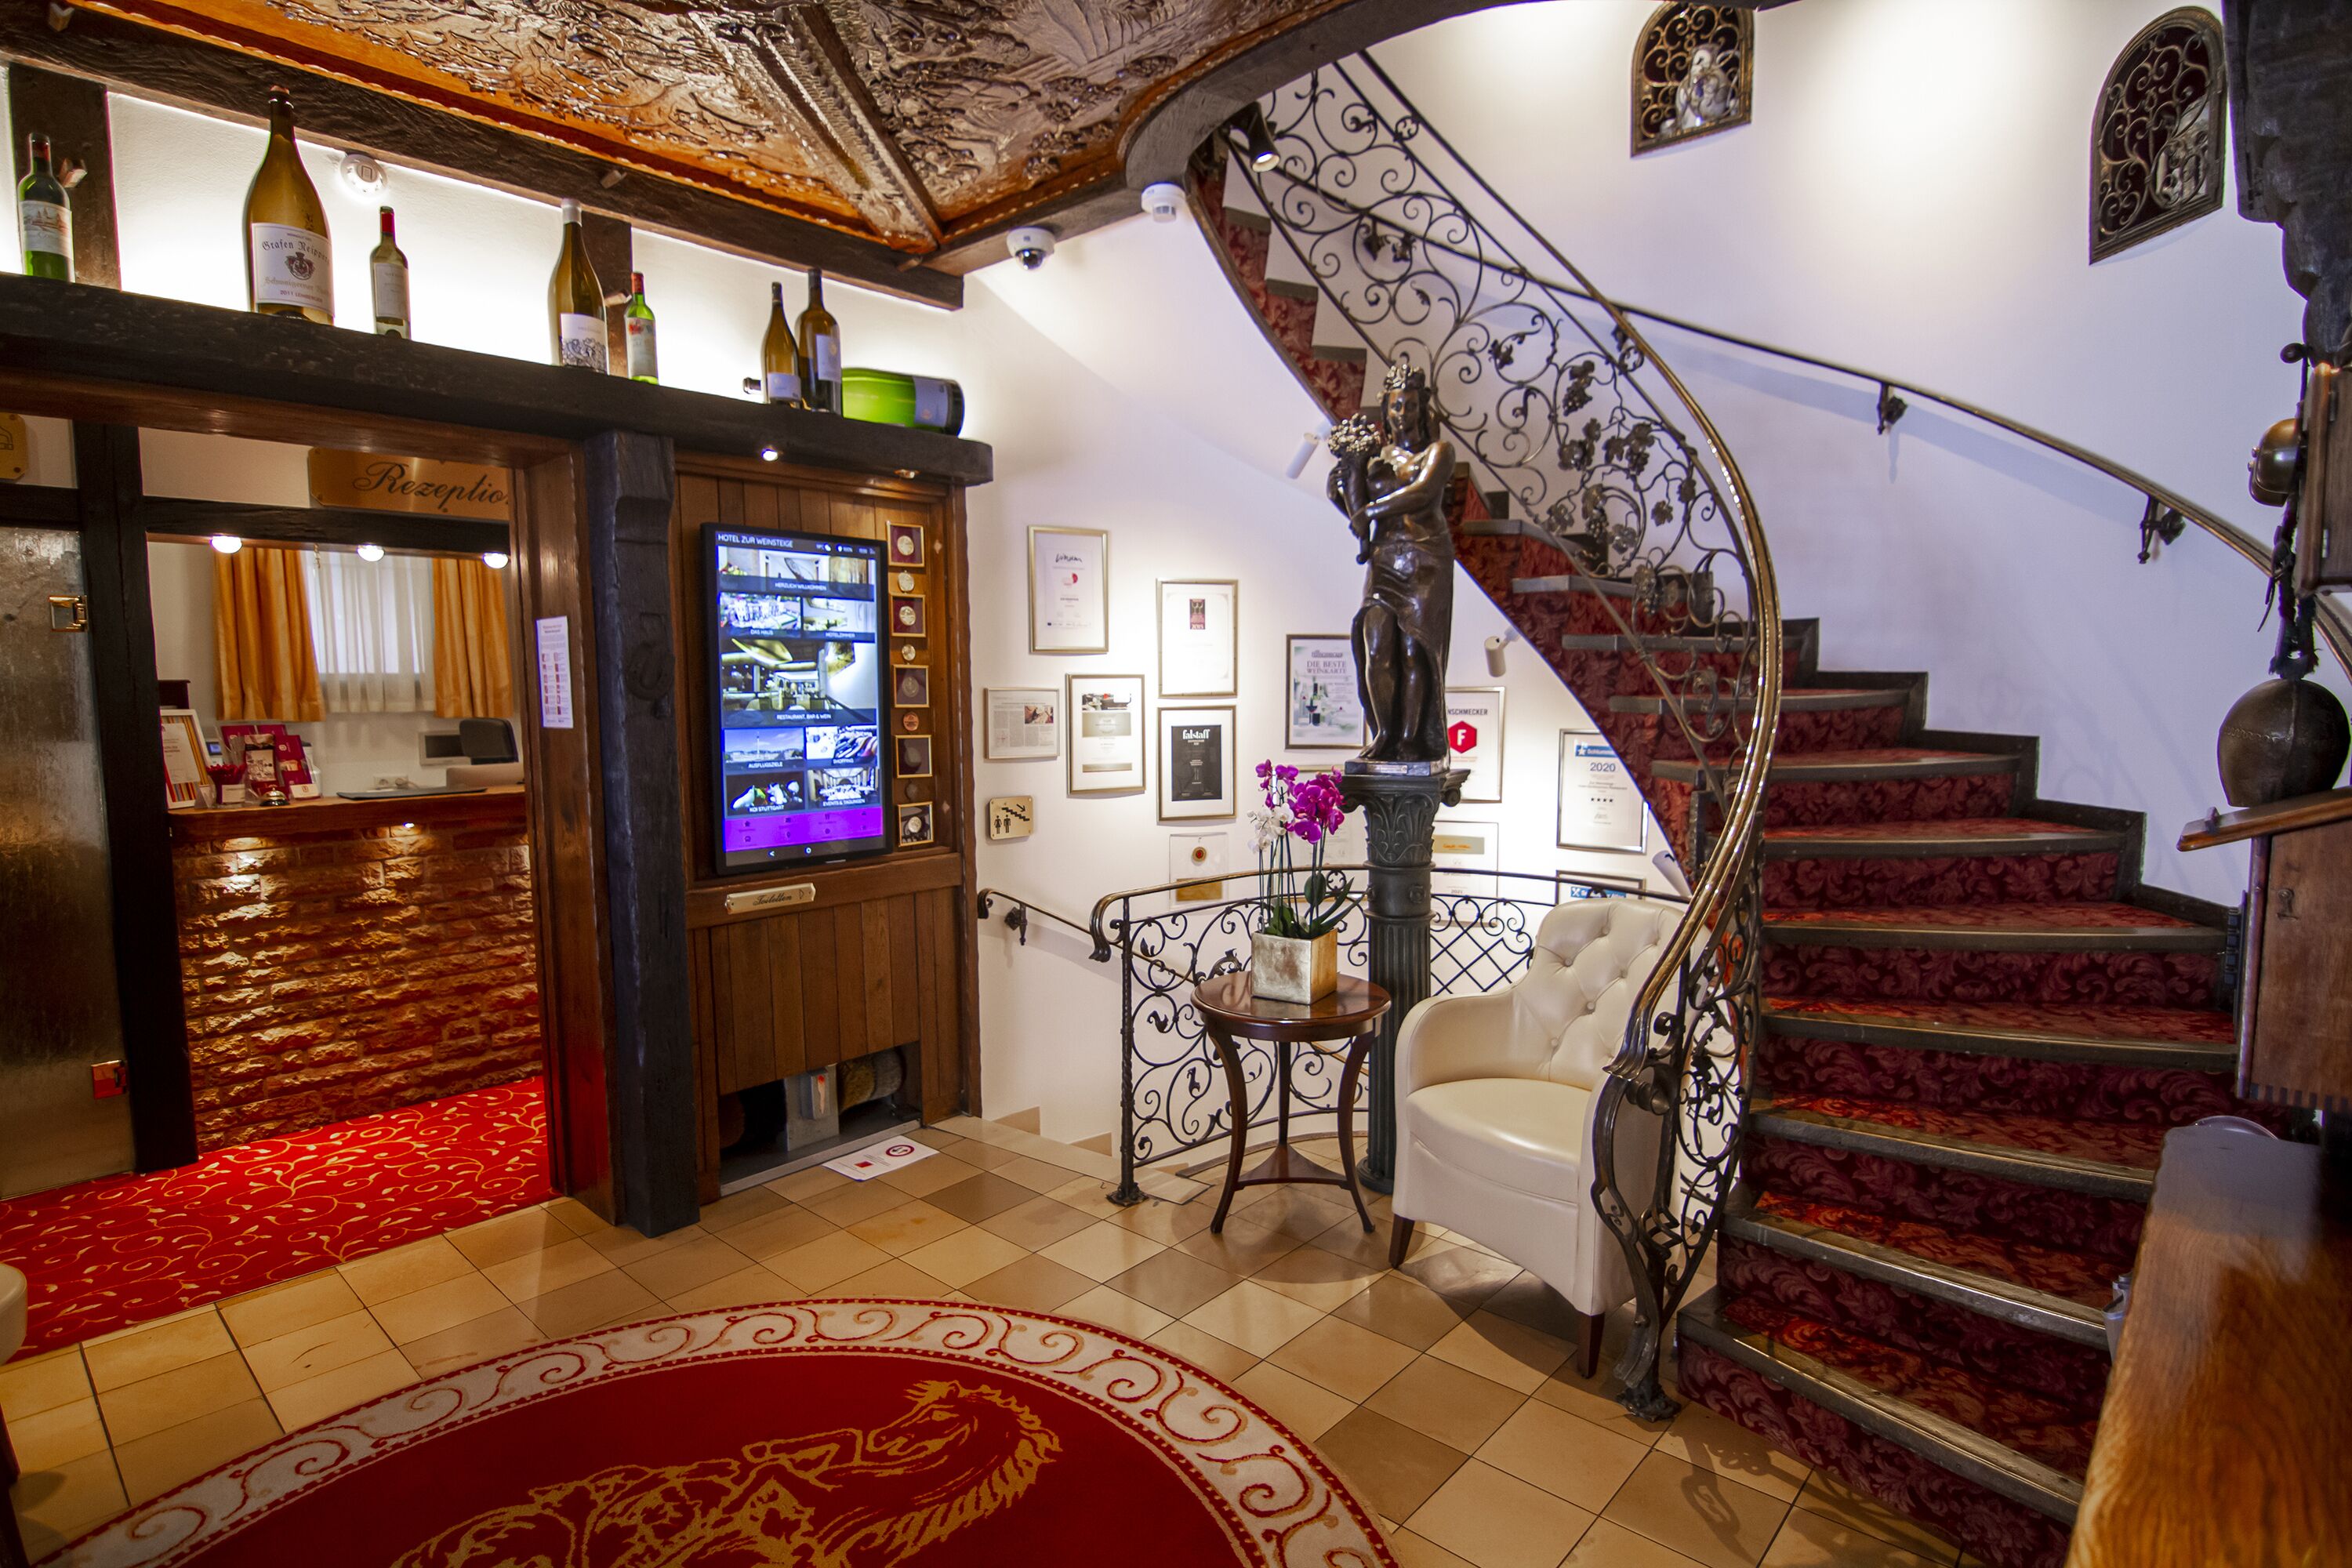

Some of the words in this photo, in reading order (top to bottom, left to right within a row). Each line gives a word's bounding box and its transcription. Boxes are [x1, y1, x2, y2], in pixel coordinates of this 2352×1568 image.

[262, 238, 294, 252] Grafen
[353, 461, 509, 510] Rezeptio
[717, 534, 740, 543] HOTEL
[742, 535, 755, 545] ZUR
[756, 537, 793, 548] WEINSTEIGE
[1182, 729, 1210, 740] falstaff
[1457, 729, 1467, 746] F
[1589, 762, 1616, 772] 2020
[753, 892, 792, 906] Toiletten
